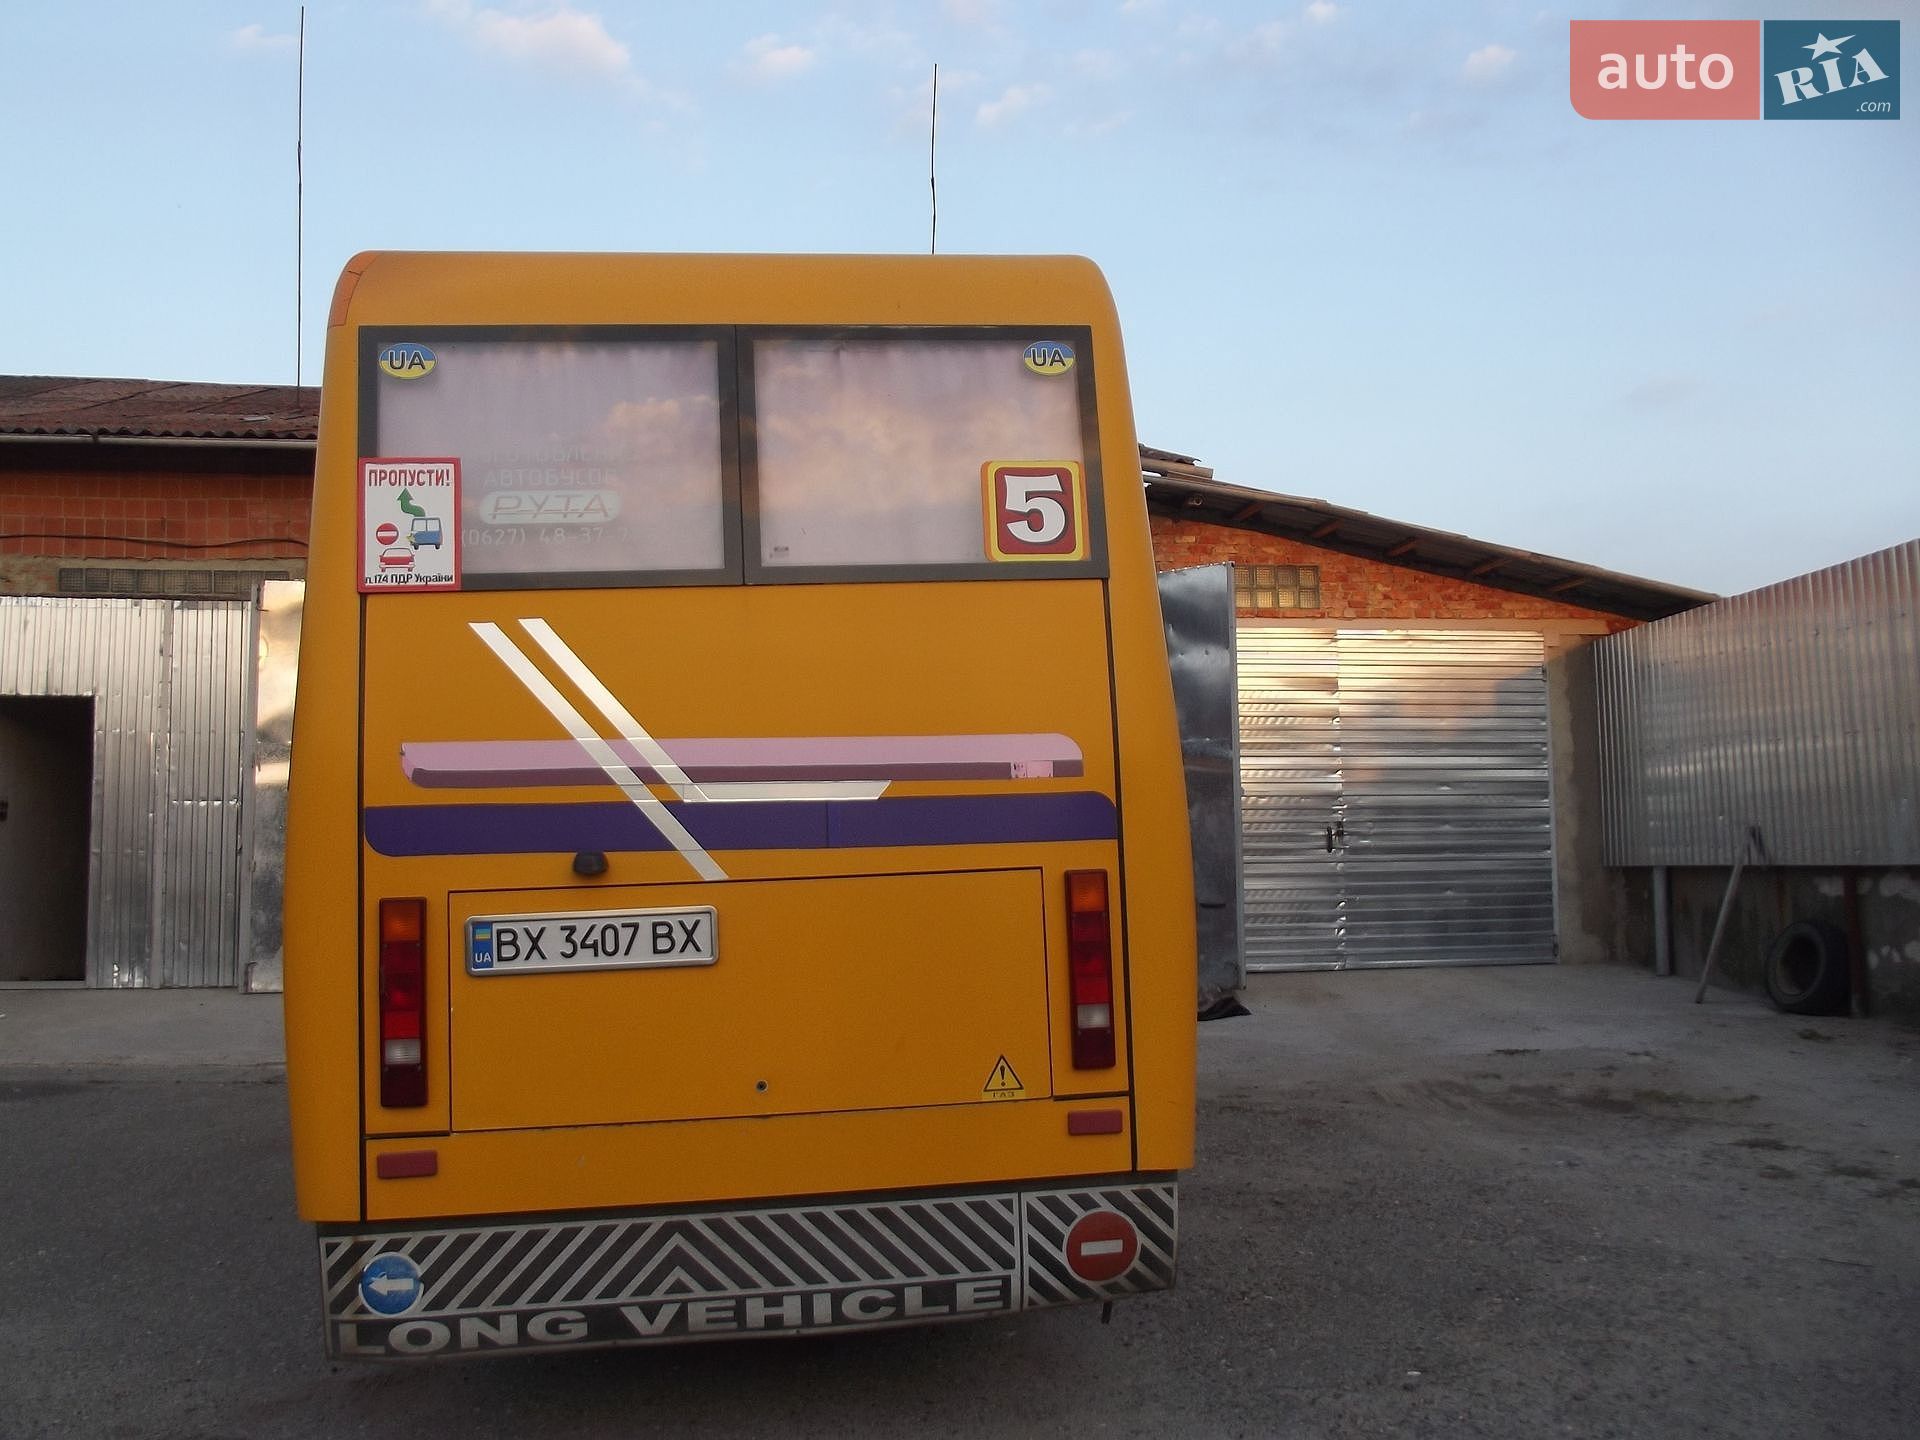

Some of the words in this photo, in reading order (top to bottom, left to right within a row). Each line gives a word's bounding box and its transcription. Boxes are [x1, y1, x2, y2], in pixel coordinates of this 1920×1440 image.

[388, 350, 426, 370] UA
[1031, 347, 1067, 368] UA
[368, 468, 451, 487] ПРОПУСТИ!
[488, 494, 609, 520] РУТА
[1004, 474, 1064, 544] 5
[391, 573, 413, 585] ПДР
[414, 572, 454, 585] України
[496, 926, 547, 962] BX
[560, 921, 640, 959] 3407
[652, 918, 702, 954] BX
[475, 952, 492, 963] UA
[340, 1309, 589, 1355] LONG
[619, 1278, 1003, 1336] VEHICLE
